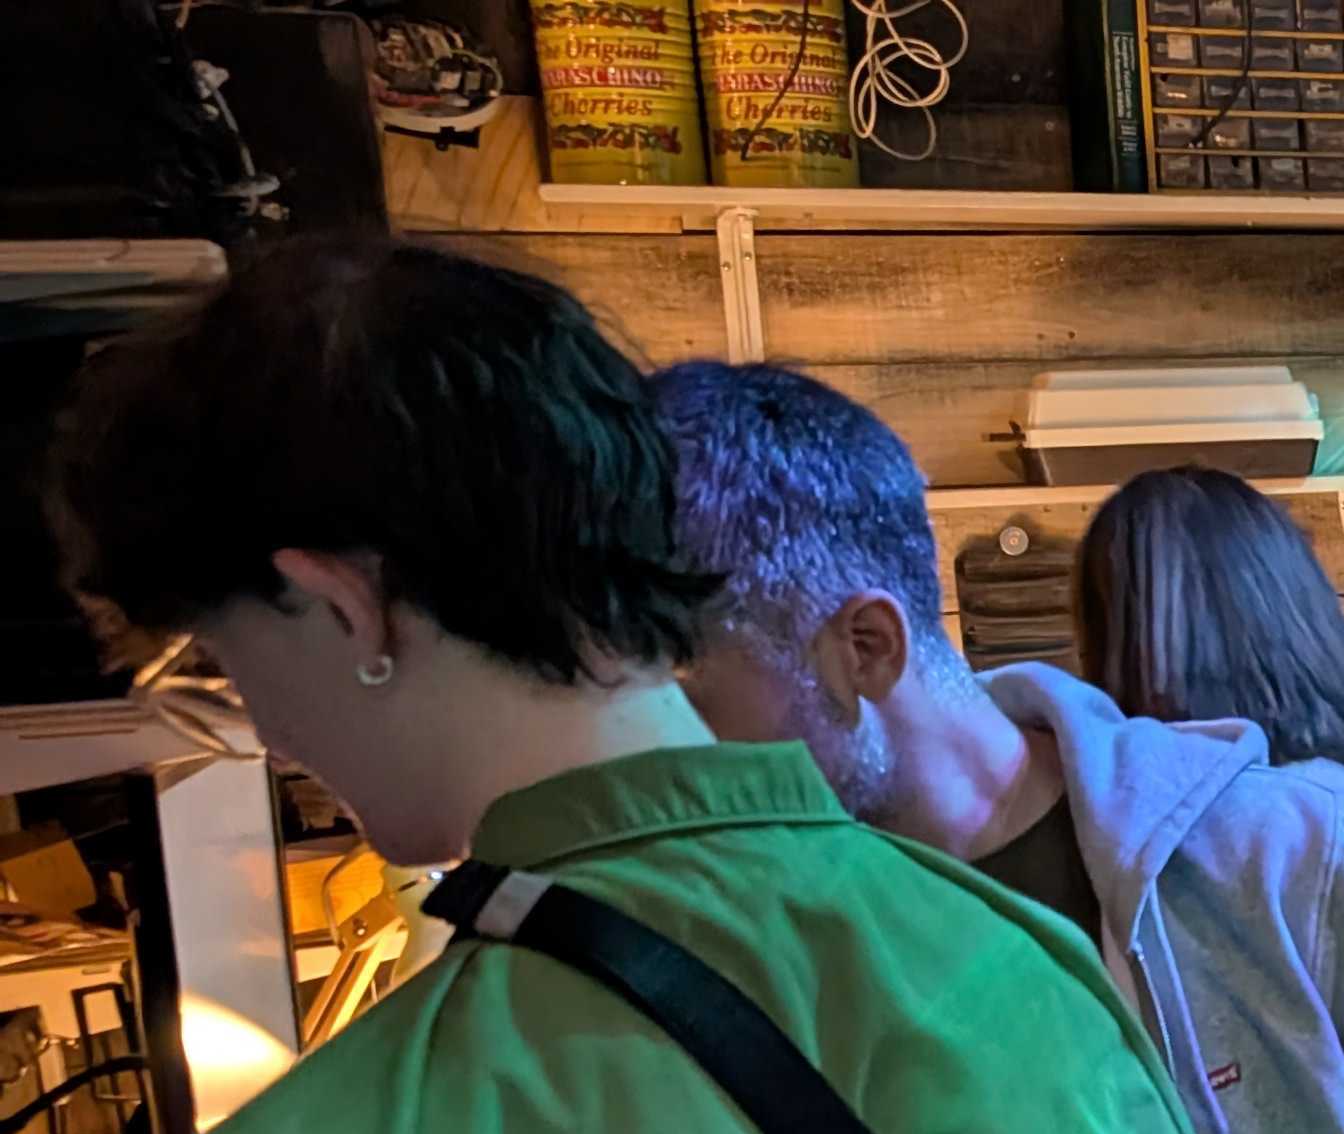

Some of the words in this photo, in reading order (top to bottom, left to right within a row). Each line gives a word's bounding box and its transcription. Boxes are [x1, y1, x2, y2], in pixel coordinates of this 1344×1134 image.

[565, 38, 660, 64] Original
[550, 92, 653, 116] Cherries
[726, 96, 832, 122] Chrries
